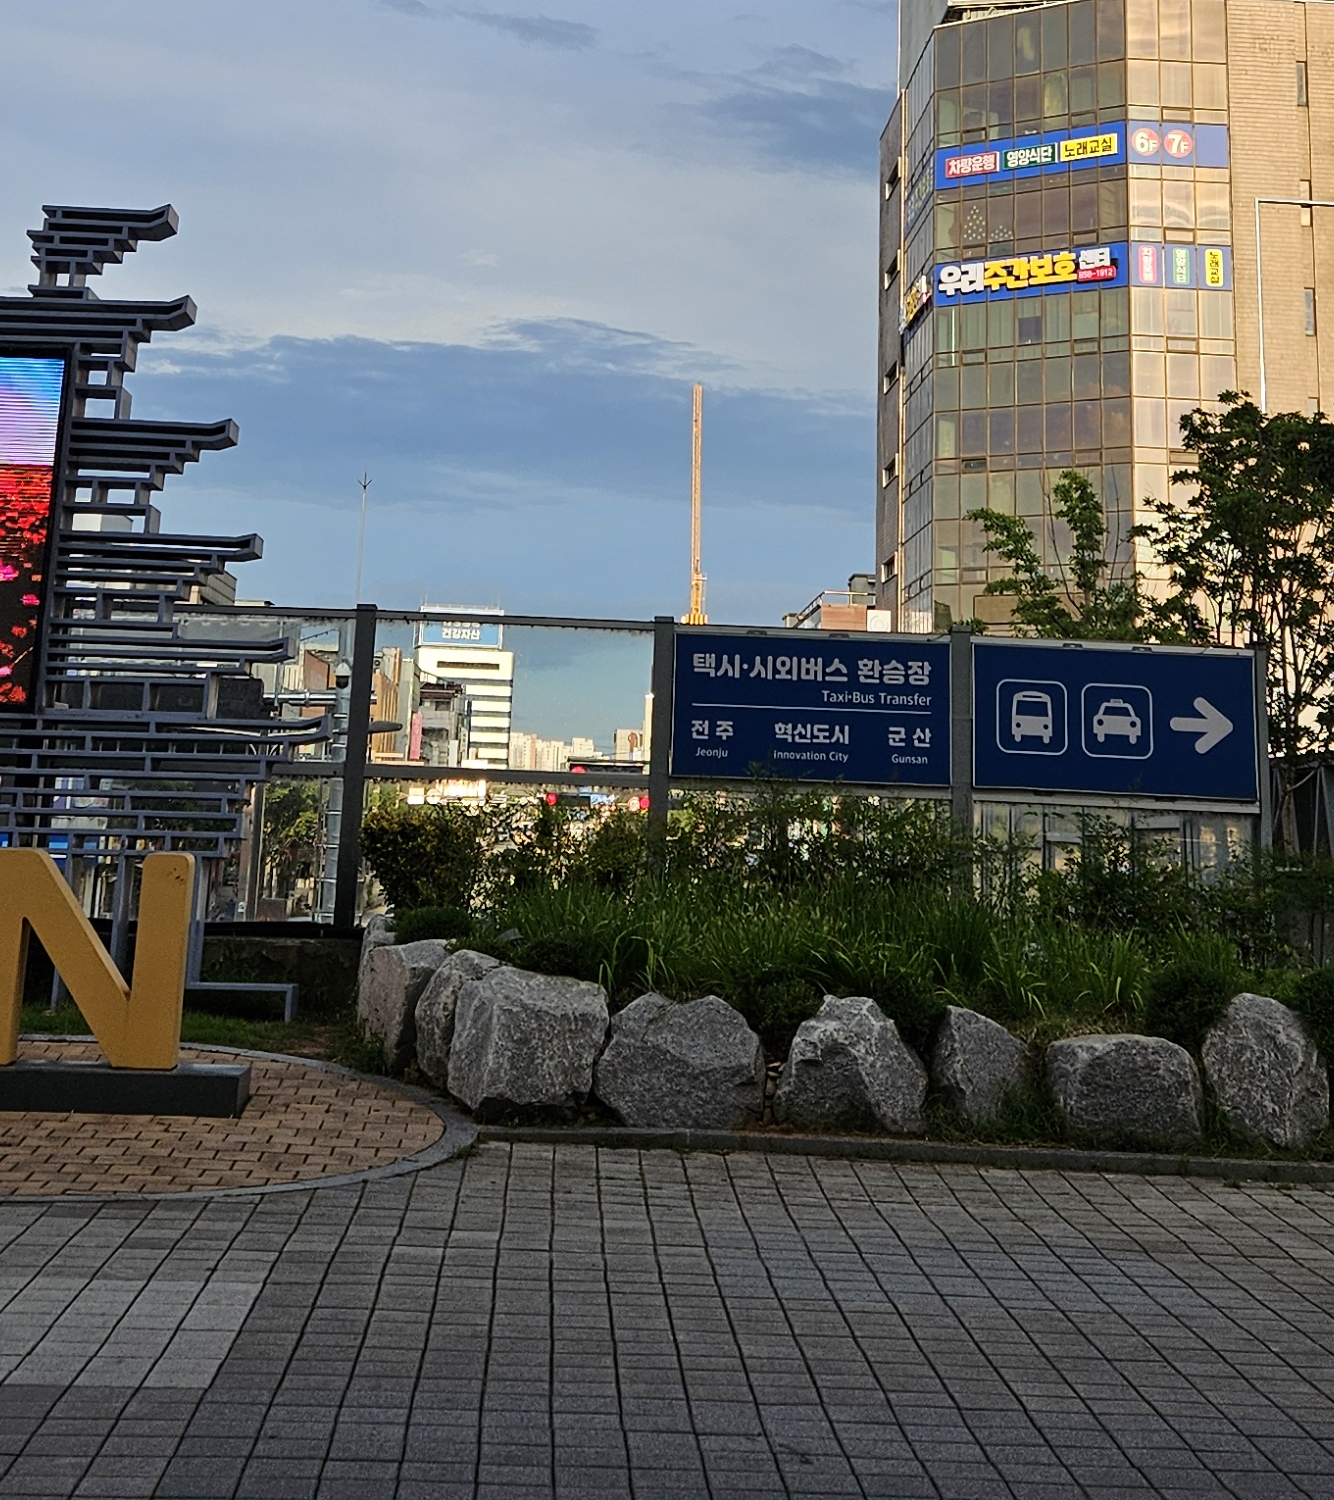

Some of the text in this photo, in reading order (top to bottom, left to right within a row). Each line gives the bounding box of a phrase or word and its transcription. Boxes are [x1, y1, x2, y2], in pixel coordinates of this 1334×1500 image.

[1134, 132, 1189, 155] 6F 7F
[947, 135, 1113, 176] 차량운행 영양식단 노래교실
[692, 653, 932, 686] 택시·시외버스 환승장
[879, 693, 932, 706] Transfer
[774, 722, 850, 745] 혁신도시
[695, 747, 728, 759] Jeonju
[829, 751, 849, 763] City
[891, 754, 928, 764] Gunsan
